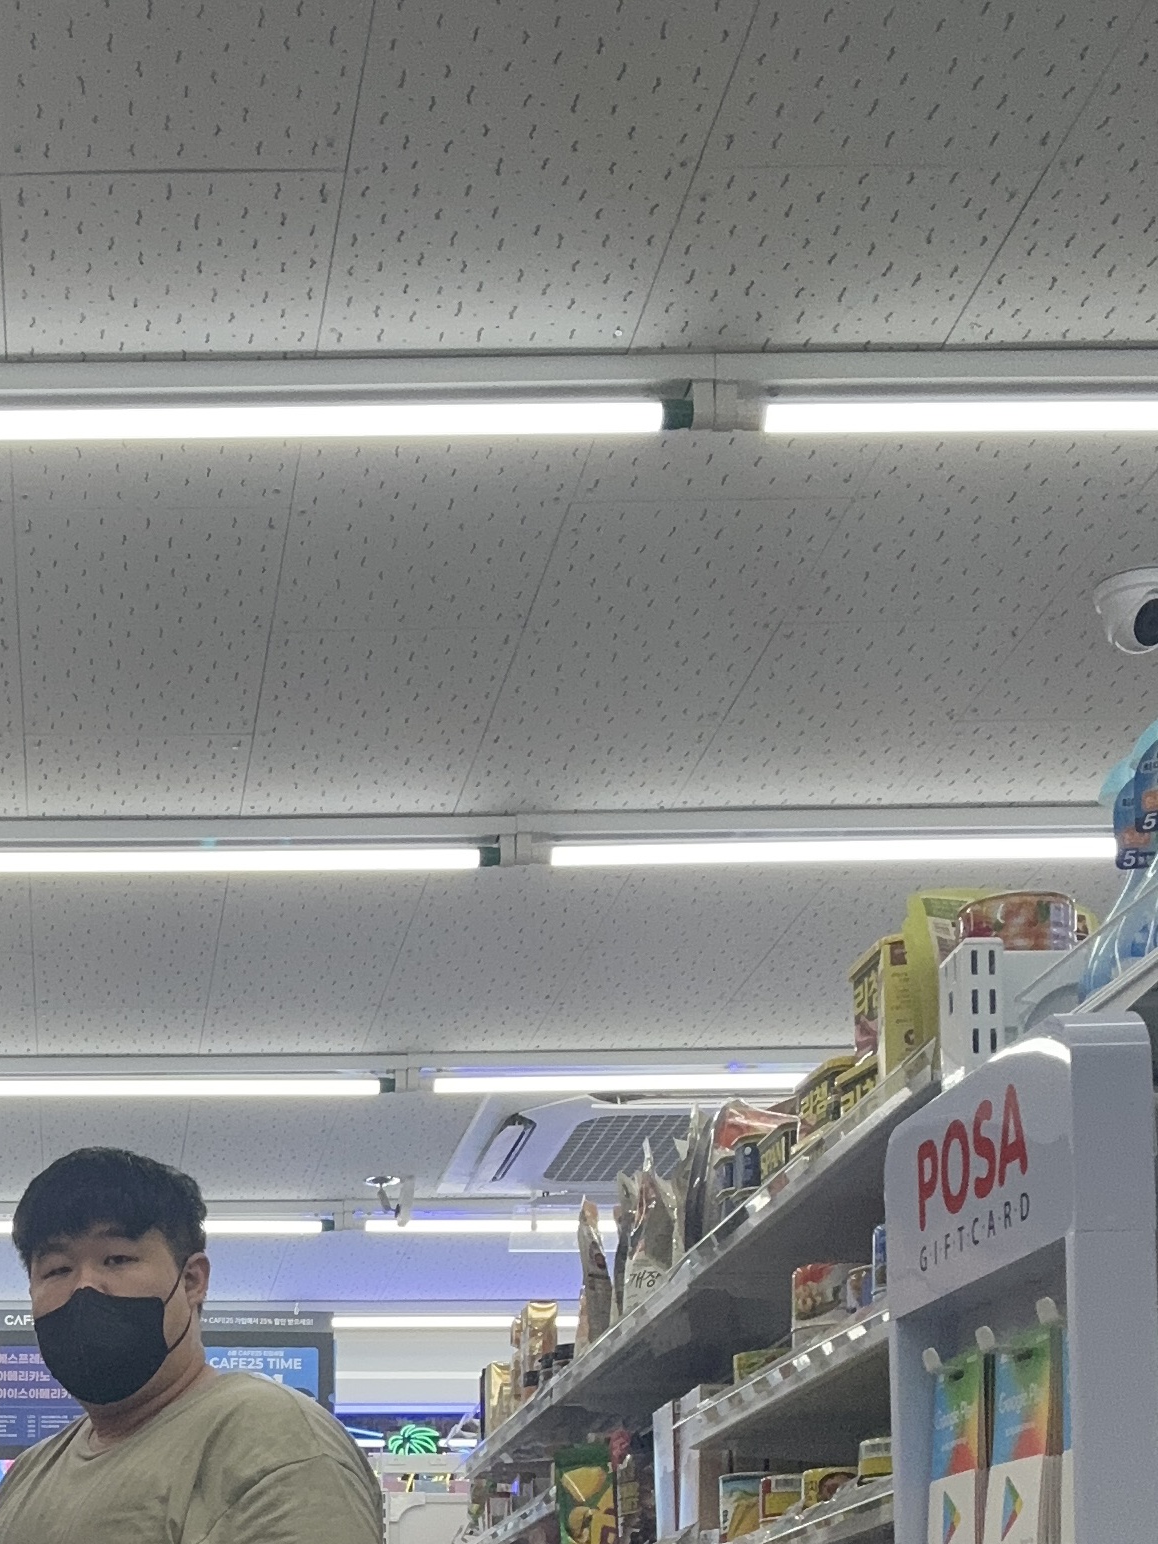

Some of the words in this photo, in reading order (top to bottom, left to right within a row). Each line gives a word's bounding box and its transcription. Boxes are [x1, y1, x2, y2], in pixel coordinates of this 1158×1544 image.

[917, 1083, 1028, 1231] POSA
[209, 1357, 264, 1370] CAFE25
[267, 1358, 302, 1370] TIME
